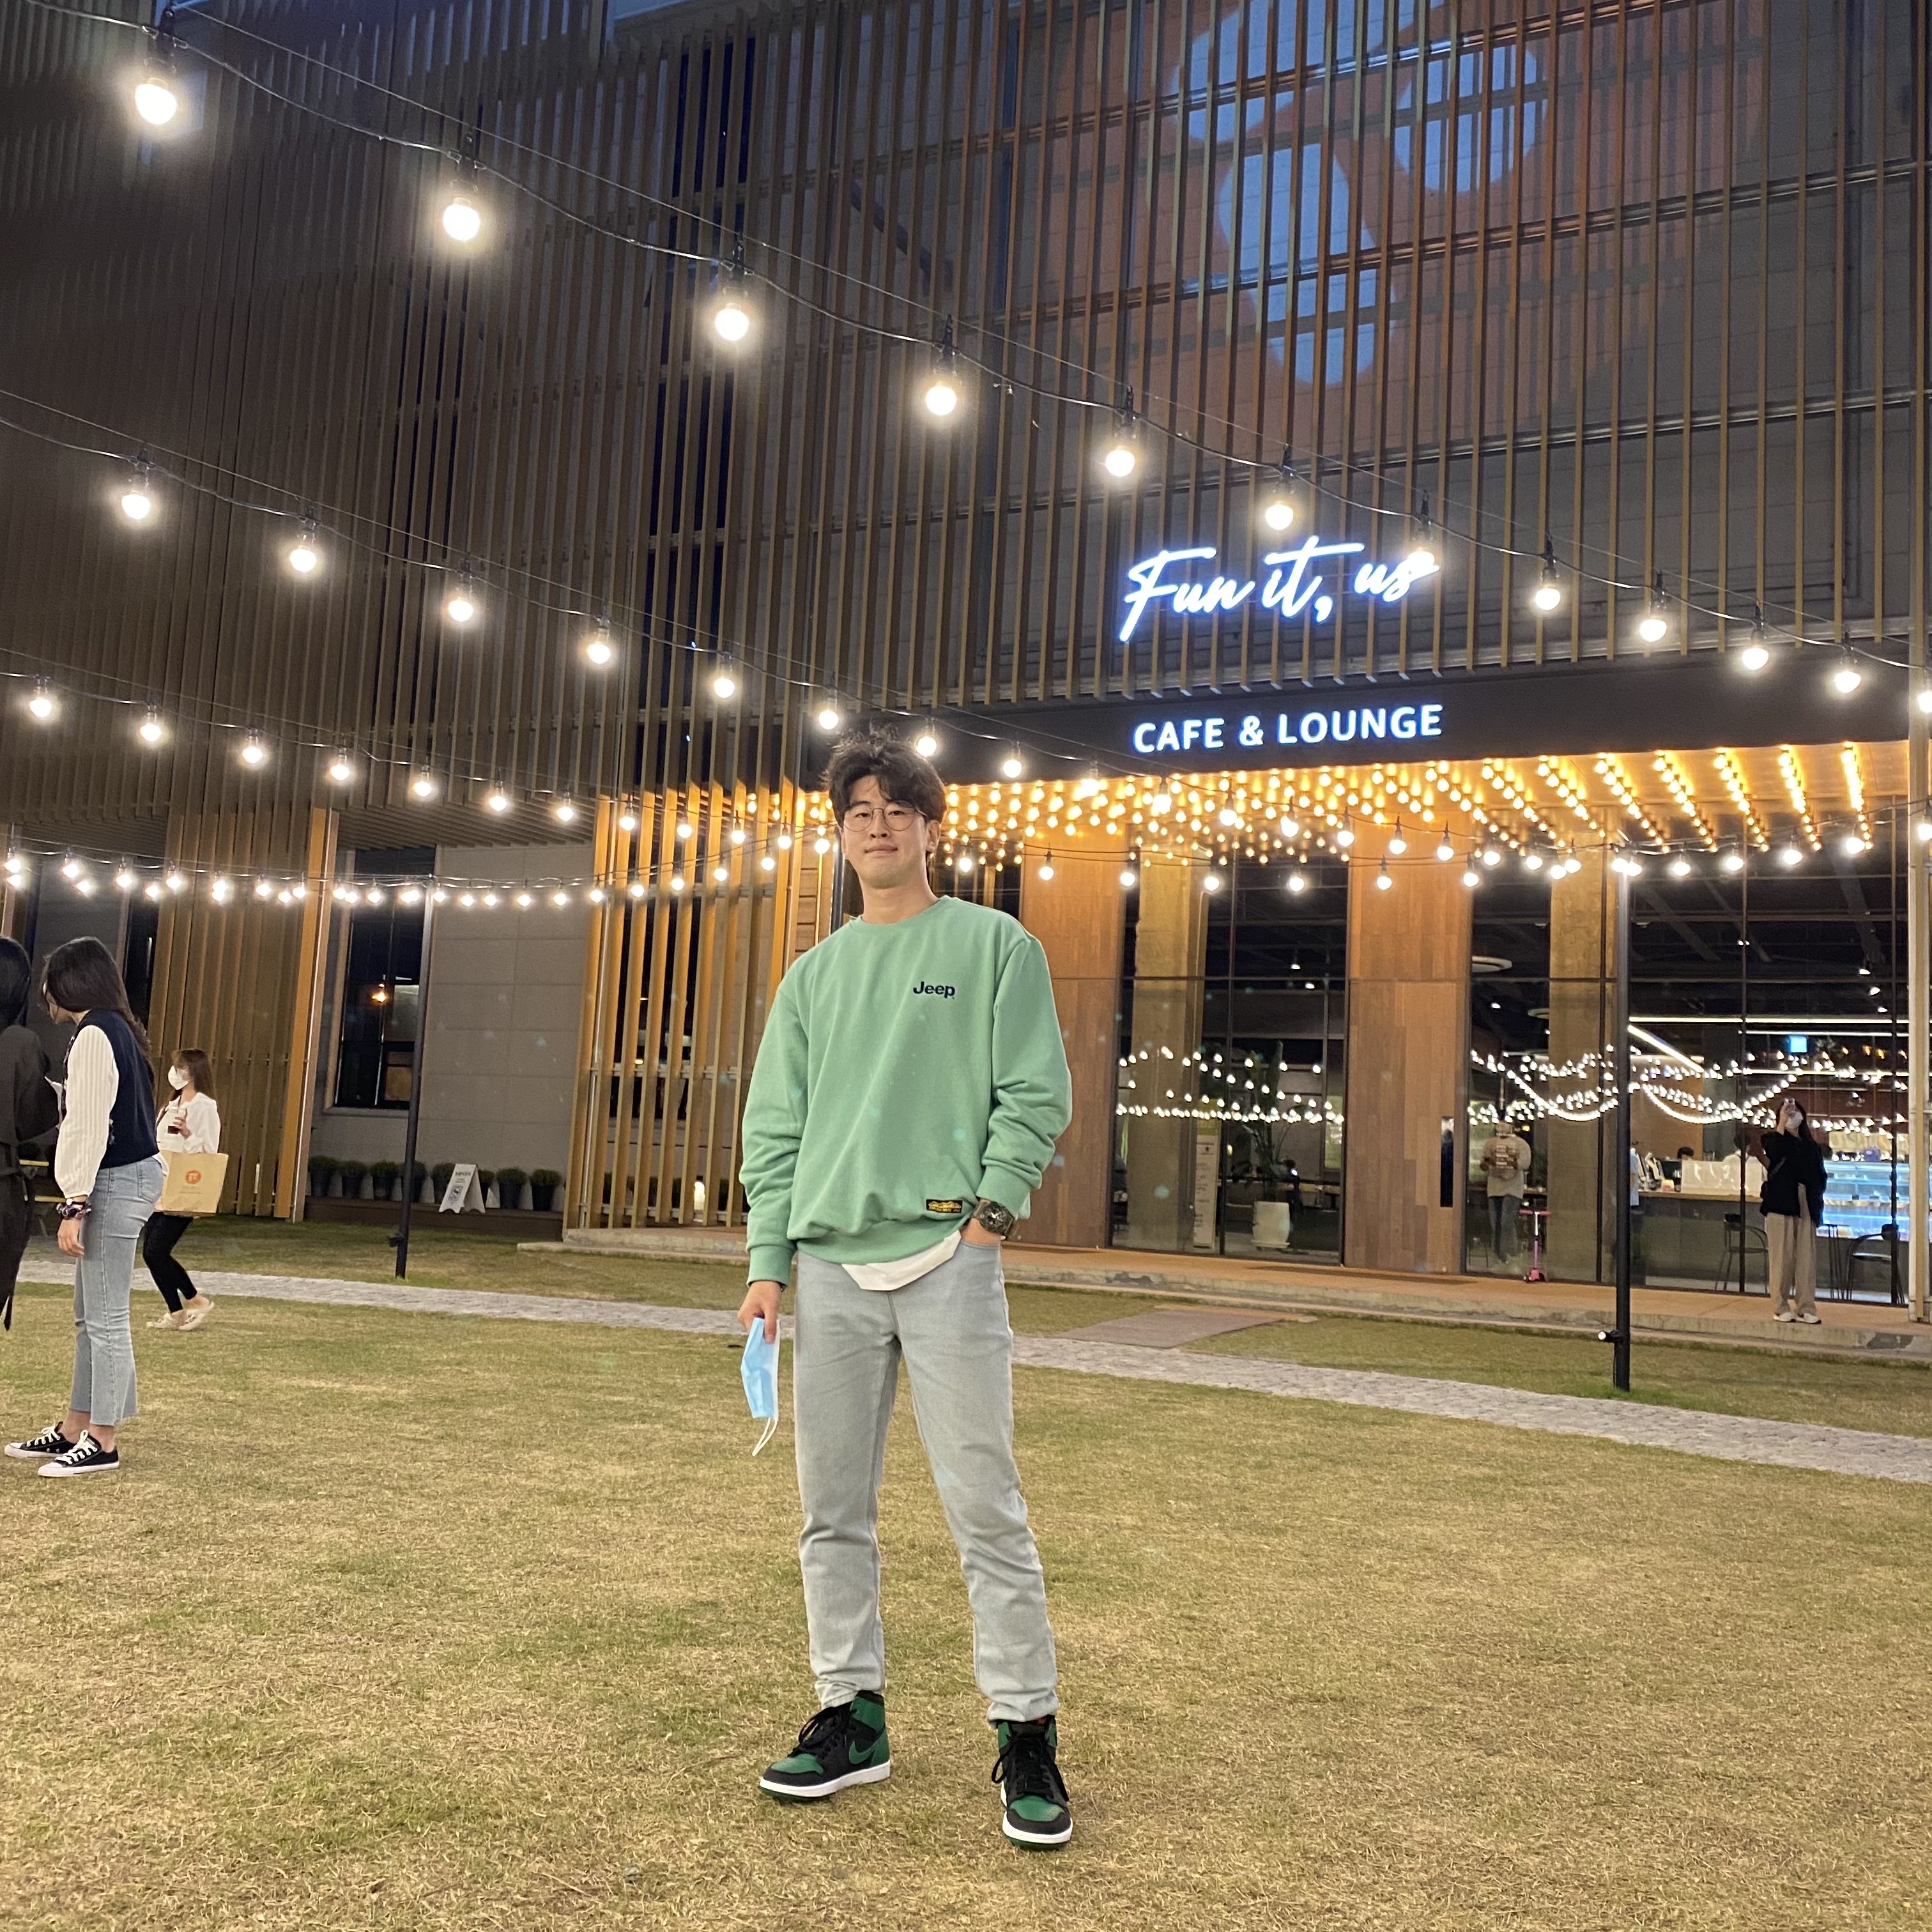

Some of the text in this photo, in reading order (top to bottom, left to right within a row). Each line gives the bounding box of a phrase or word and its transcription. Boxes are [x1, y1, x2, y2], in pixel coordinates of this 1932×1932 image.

[1119, 535, 1440, 643] Fun it, us
[1133, 704, 1443, 754] CAFE & LOUNGE
[913, 981, 955, 999] Jeep
